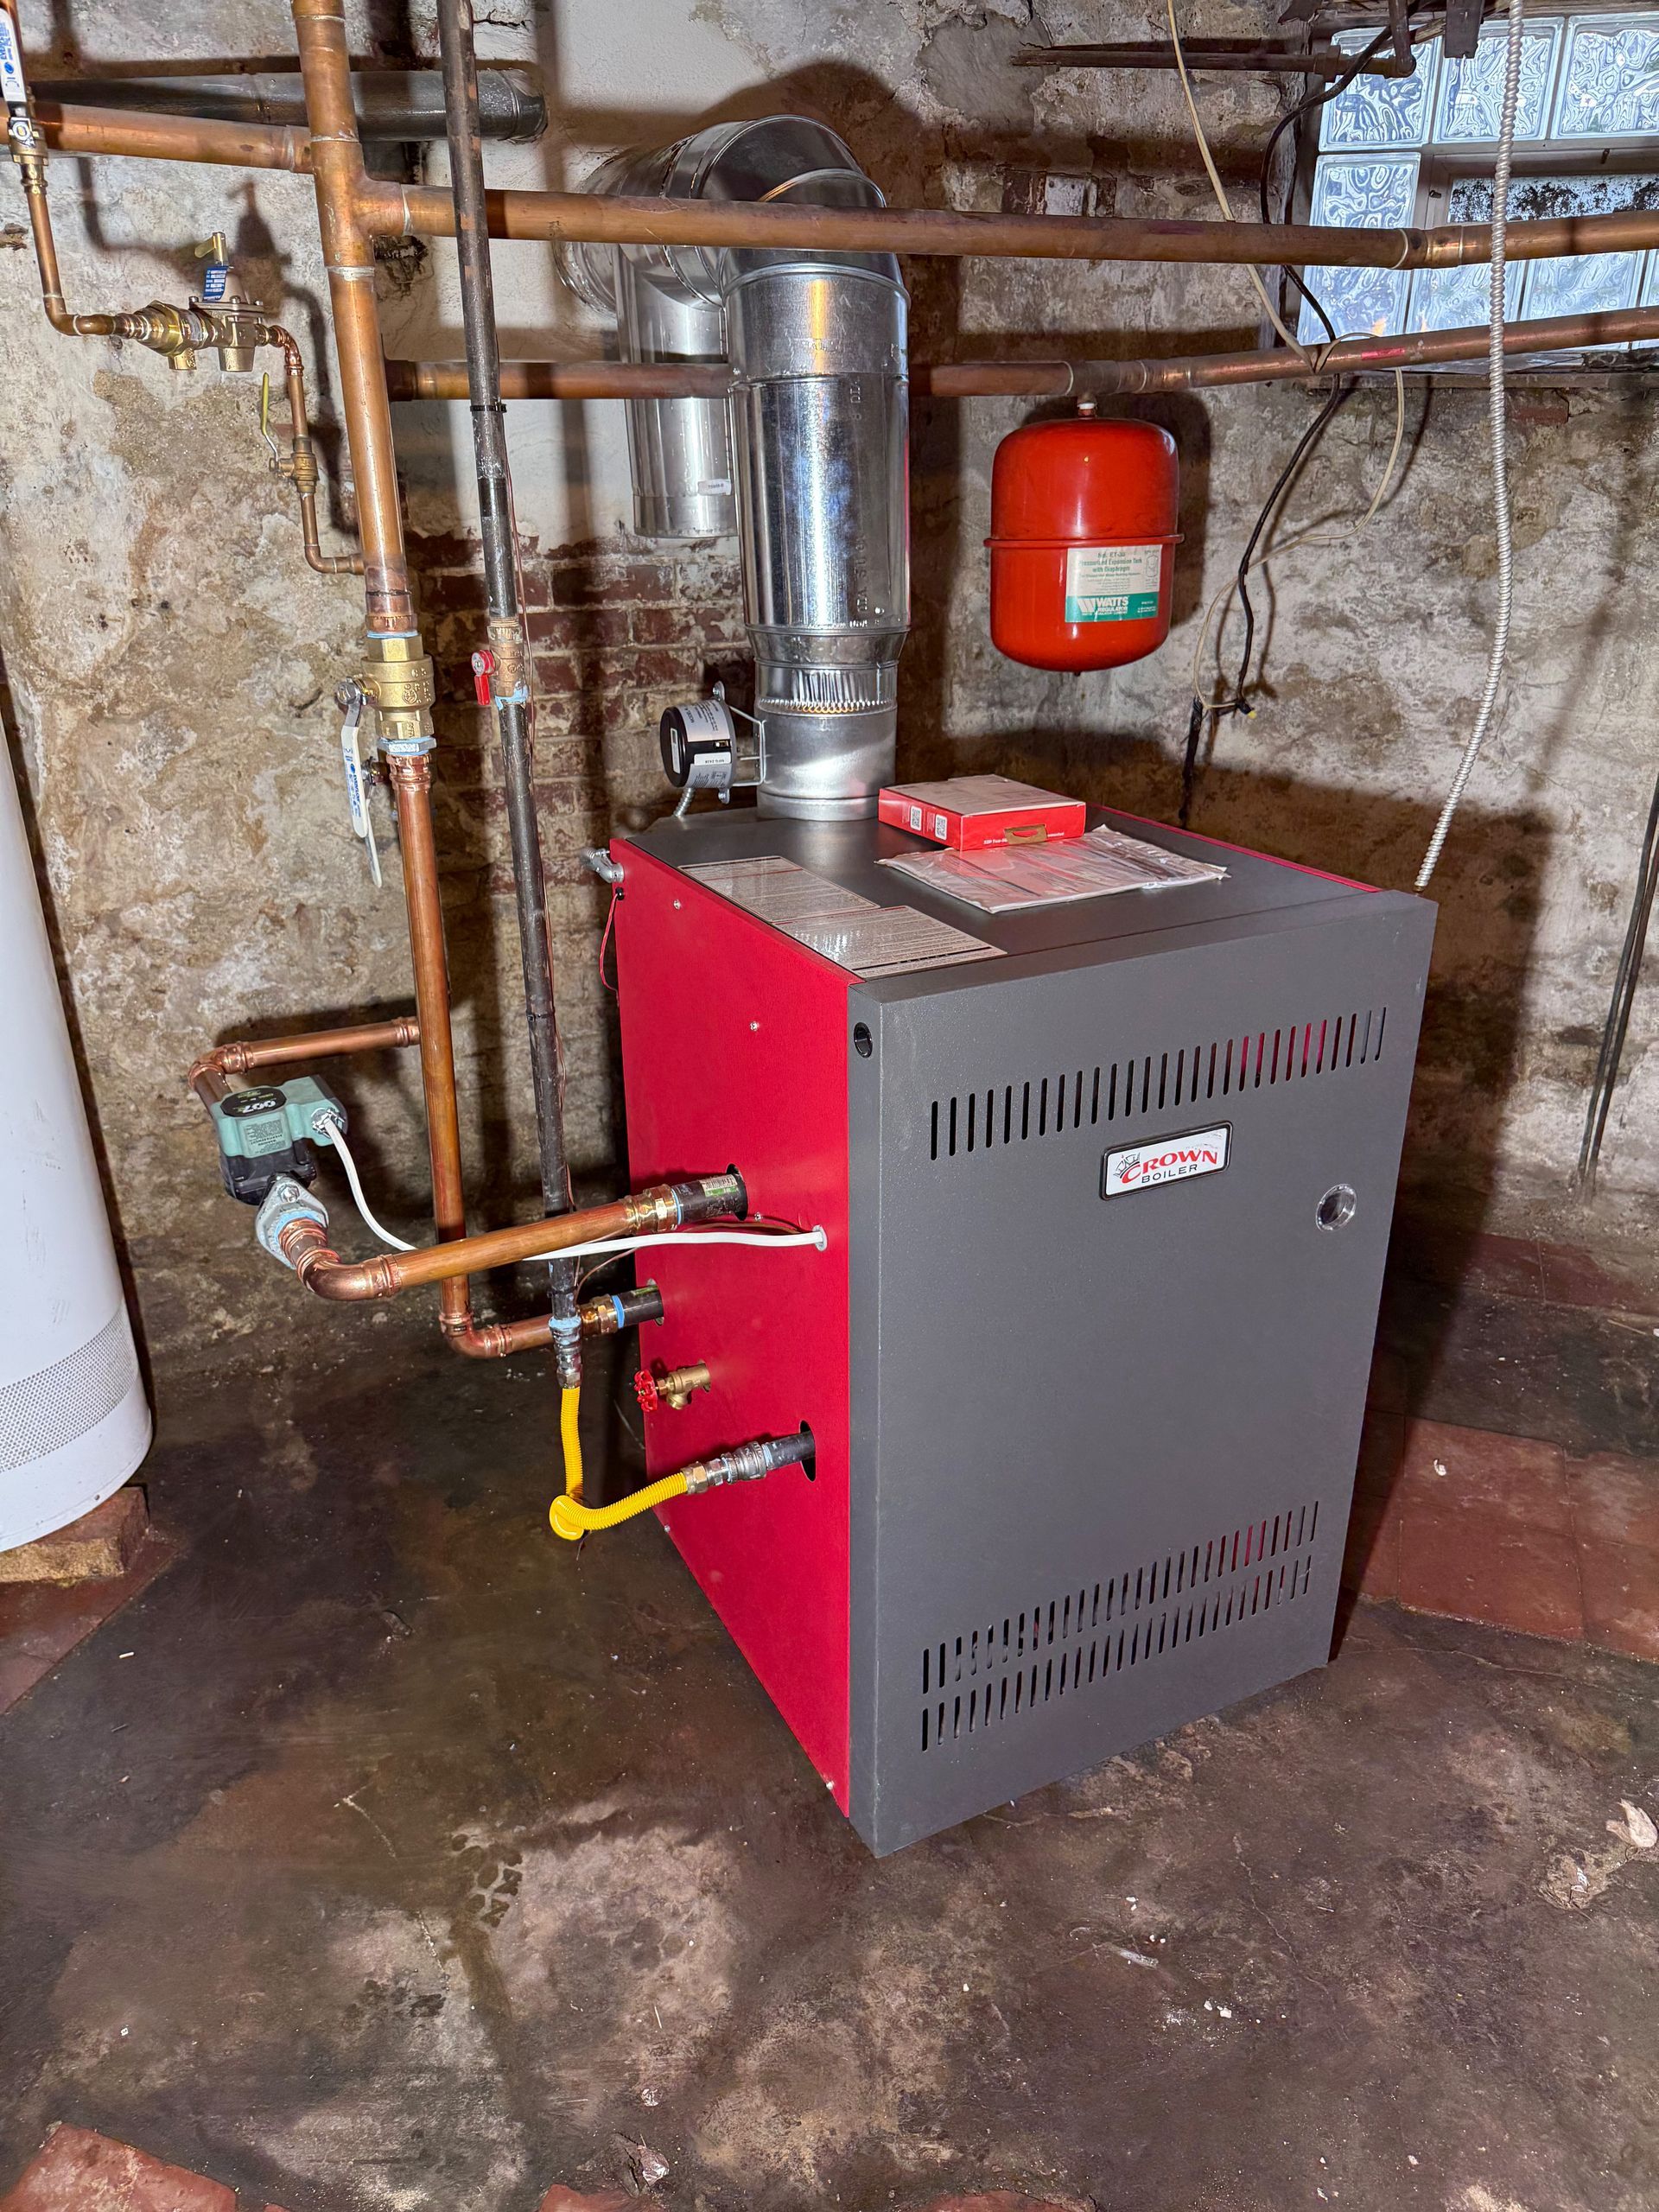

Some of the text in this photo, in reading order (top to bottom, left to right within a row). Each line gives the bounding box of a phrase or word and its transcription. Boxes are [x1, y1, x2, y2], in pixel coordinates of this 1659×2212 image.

[1096, 595, 1129, 607] WATTS
[1121, 1148, 1218, 1185] CROWN
[1141, 1163, 1198, 1184] BOILER
